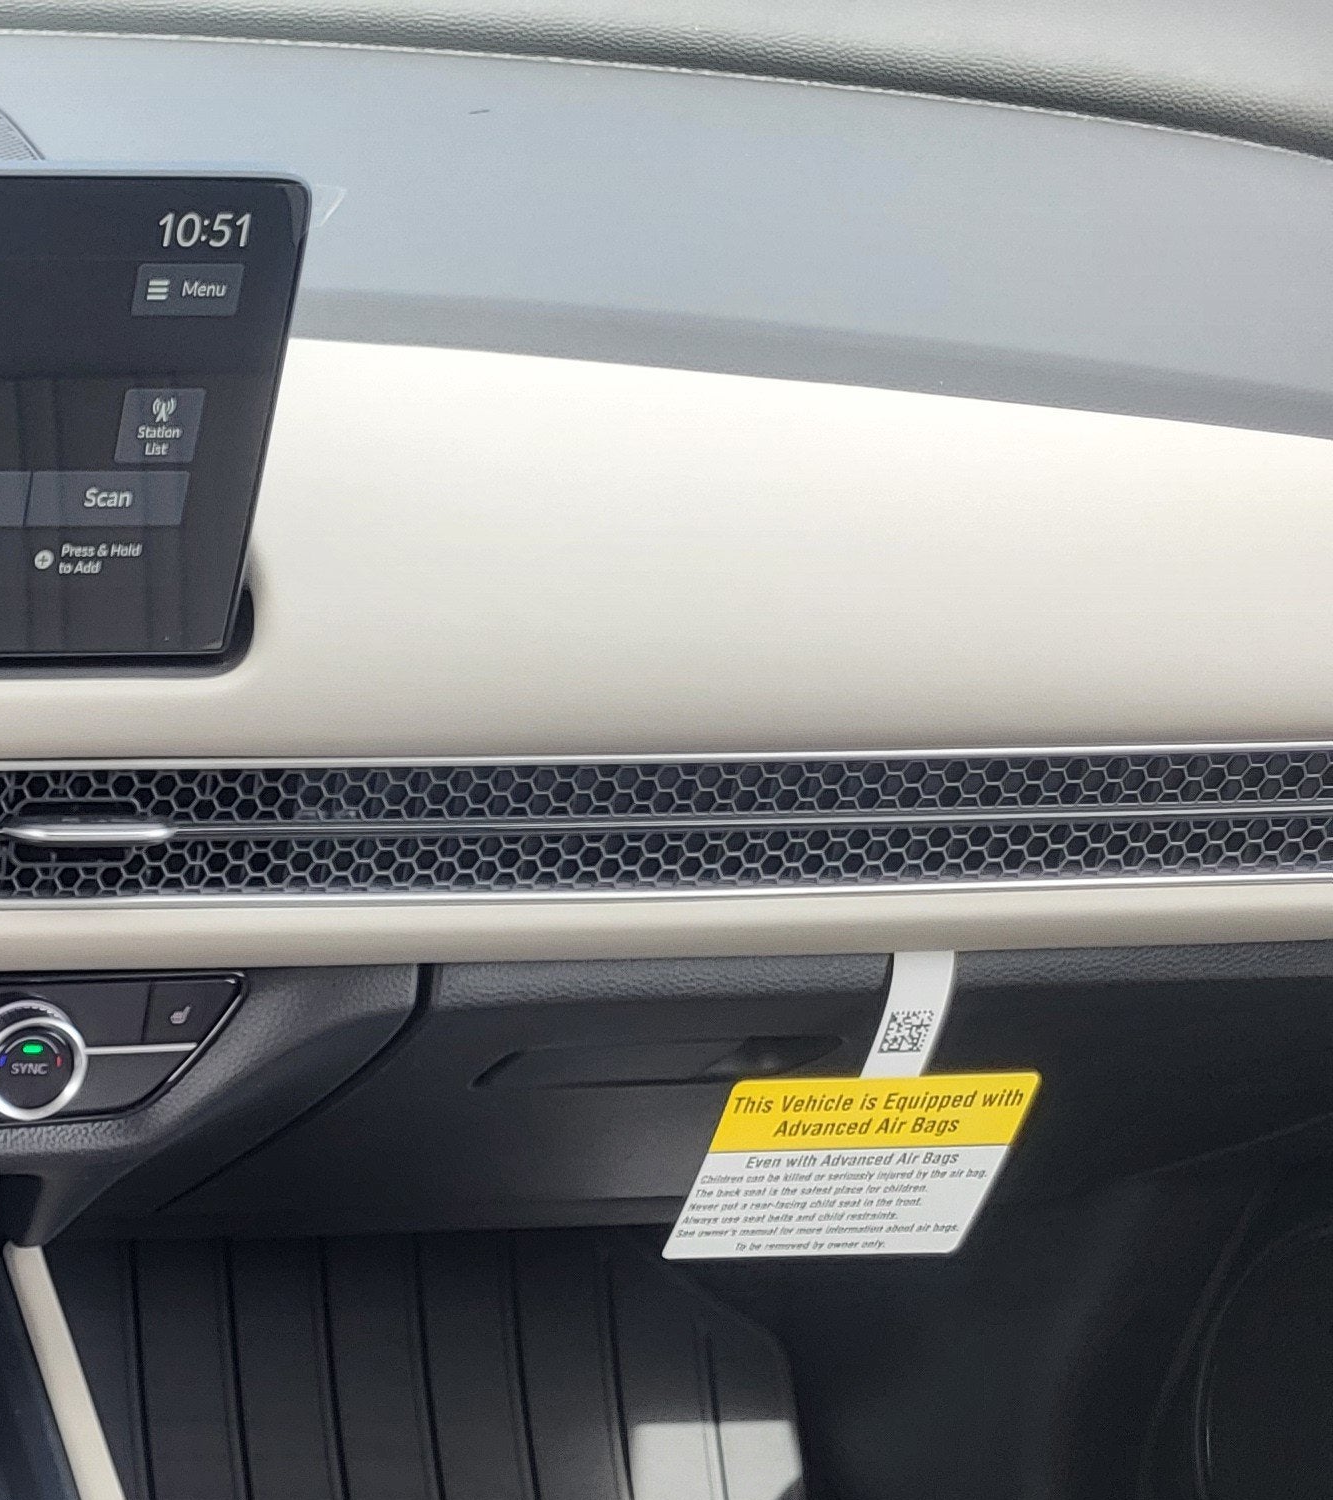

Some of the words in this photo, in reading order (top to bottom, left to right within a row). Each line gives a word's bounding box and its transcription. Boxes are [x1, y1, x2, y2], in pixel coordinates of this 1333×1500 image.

[158, 212, 252, 248] 10:51
[182, 280, 227, 297] Menu
[137, 425, 181, 440] Station
[145, 442, 169, 456] List
[83, 487, 133, 508] Scan
[60, 543, 96, 558] Press
[97, 544, 109, 558] &
[110, 543, 143, 558] Hold
[58, 561, 72, 575] to
[74, 560, 102, 574] Add
[10, 1062, 48, 1076] SYNC
[733, 1096, 774, 1115] This
[781, 1093, 854, 1113] Vehicle
[859, 1092, 878, 1110] is
[883, 1086, 975, 1114] Equipped
[981, 1088, 1024, 1108] with
[773, 1116, 870, 1137] Advanced
[875, 1116, 908, 1135] Air
[910, 1116, 960, 1136] Bags
[745, 1156, 783, 1169] Even
[785, 1155, 817, 1168] with
[820, 1153, 895, 1167] Advanced
[897, 1152, 919, 1166] Air
[922, 1152, 960, 1166] Bags
[700, 1174, 744, 1185] Children
[746, 1175, 765, 1183] can
[767, 1173, 780, 1183] be
[782, 1172, 811, 1182] killed
[828, 1171, 875, 1181] seriously
[876, 1170, 913, 1181] injured
[915, 1170, 929, 1179] by
[931, 1169, 947, 1178] the
[949, 1169, 964, 1177] air
[965, 1168, 988, 1179] bag.
[695, 1189, 713, 1198] The
[716, 1188, 740, 1198] back
[743, 1188, 766, 1197] seat
[769, 1187, 779, 1196] is
[781, 1187, 798, 1196] the
[800, 1186, 832, 1196] safest
[834, 1185, 863, 1196] place
[865, 1185, 881, 1194] for
[883, 1183, 928, 1193] children.
[687, 1203, 719, 1212] Never
[721, 1202, 738, 1212] put
[749, 1200, 808, 1210] rear-facing
[809, 1199, 836, 1208] child
[837, 1199, 862, 1208] seat
[863, 1198, 874, 1207] in
[875, 1197, 893, 1207] the
[894, 1196, 922, 1207] front.
[682, 1216, 719, 1226] Always
[721, 1216, 740, 1224] use
[742, 1214, 766, 1223] seat
[767, 1213, 794, 1223] belts
[796, 1213, 816, 1222] and
[818, 1212, 844, 1221] child
[845, 1210, 899, 1221] restraints.
[735, 1242, 746, 1251] To
[749, 1241, 762, 1251] be
[764, 1240, 812, 1250] removed
[814, 1240, 825, 1251] by
[827, 1241, 860, 1249] owner
[861, 1239, 886, 1251] only.
